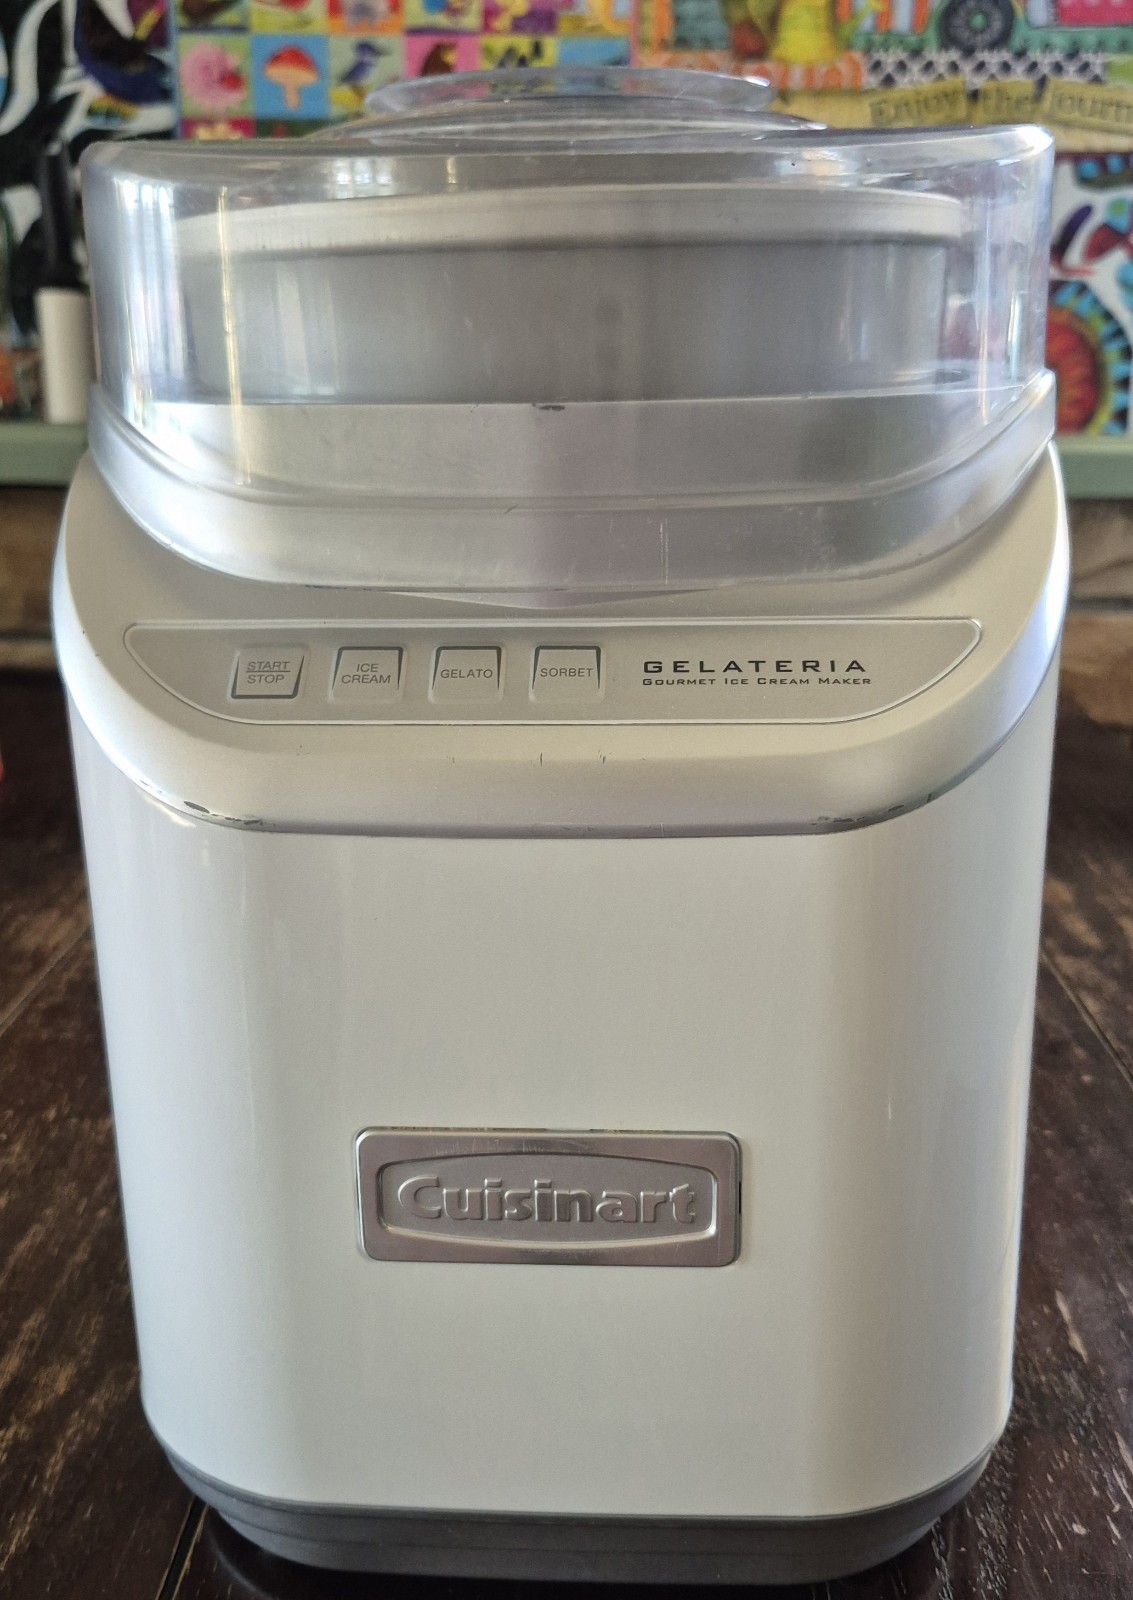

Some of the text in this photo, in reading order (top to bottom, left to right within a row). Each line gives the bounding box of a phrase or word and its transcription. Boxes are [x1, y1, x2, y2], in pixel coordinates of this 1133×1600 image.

[247, 661, 290, 671] START
[356, 663, 379, 673] ICE
[643, 660, 866, 673] GELATERIA
[440, 668, 493, 679] GELATO
[540, 667, 593, 678] SORBET
[247, 674, 285, 684] STOP
[341, 674, 391, 684] CREAM
[398, 1174, 696, 1224] Cuisinart
